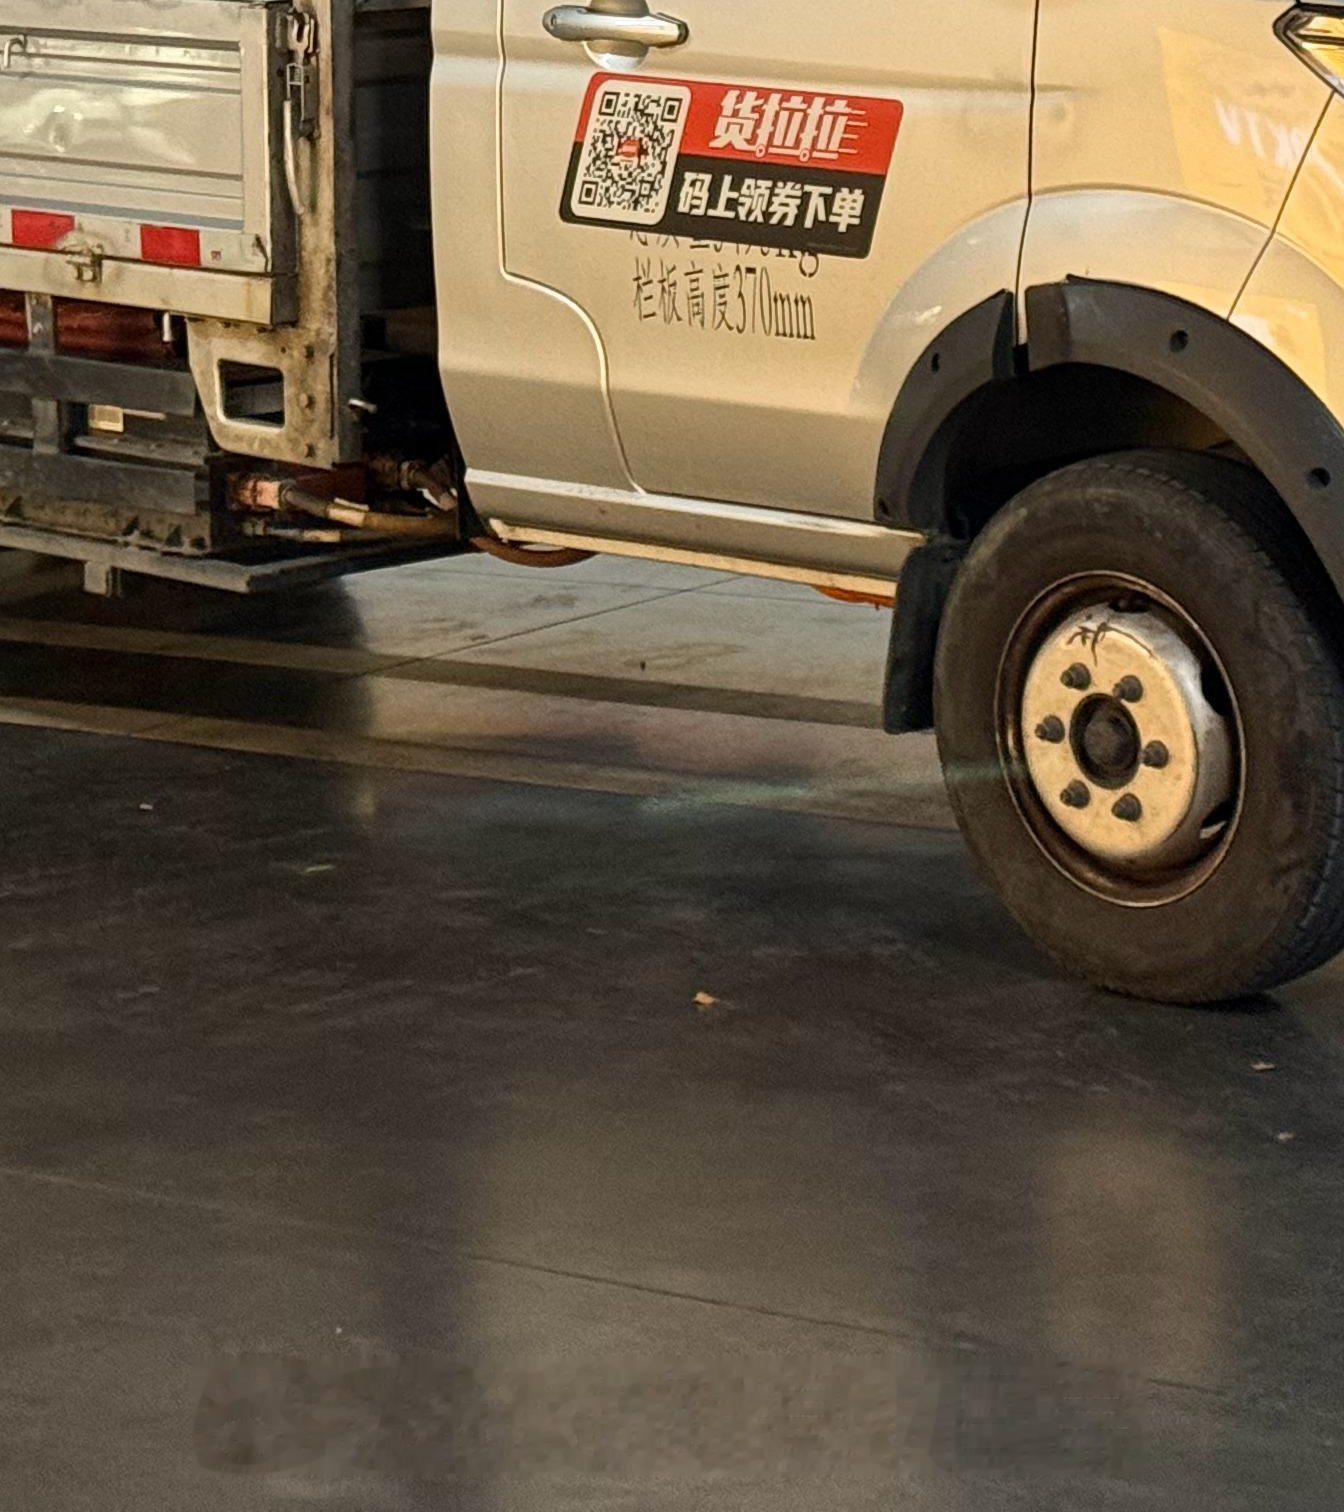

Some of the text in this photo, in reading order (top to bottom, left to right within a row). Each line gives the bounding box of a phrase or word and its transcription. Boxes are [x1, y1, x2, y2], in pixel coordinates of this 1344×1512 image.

[708, 89, 856, 162] 货拉拉
[676, 170, 866, 233] 码上领券下单
[632, 257, 816, 340] 栏板高度370mm
